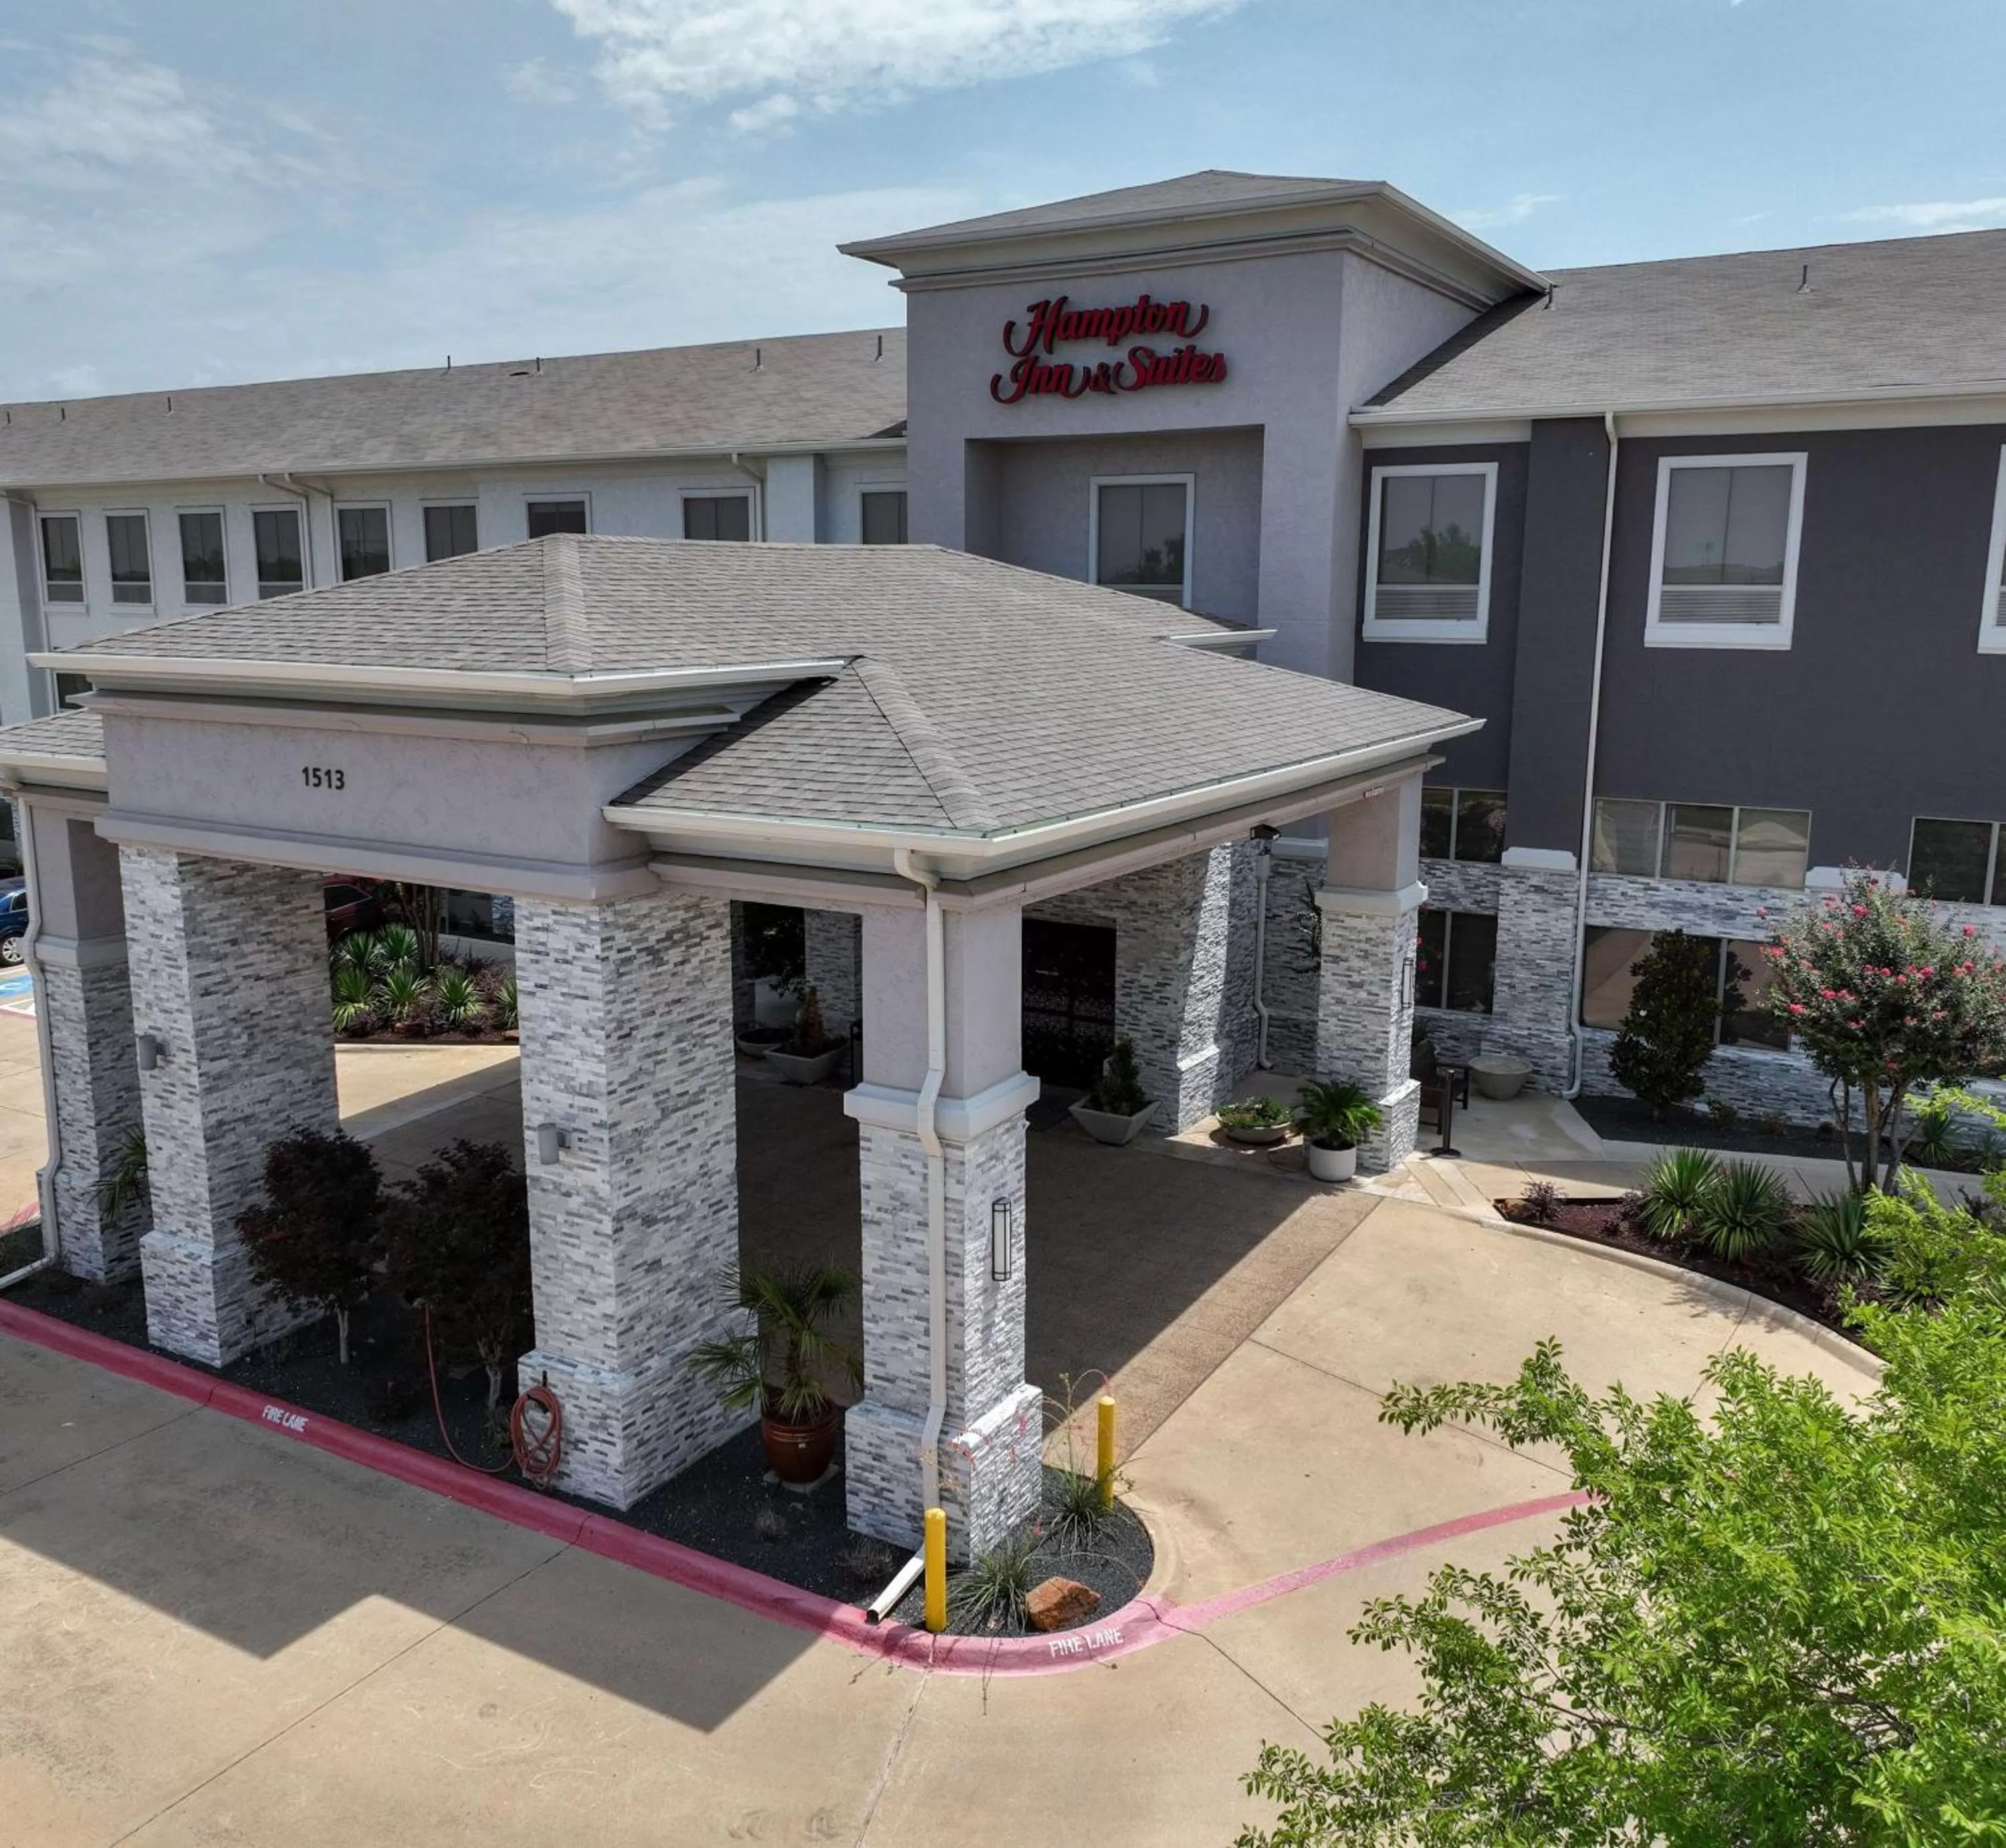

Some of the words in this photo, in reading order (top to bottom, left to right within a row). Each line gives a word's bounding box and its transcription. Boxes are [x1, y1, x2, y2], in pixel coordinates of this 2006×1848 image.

[1003, 294, 1210, 357] Hampton
[990, 355, 1091, 404] Inn
[1090, 362, 1117, 395] &
[1113, 344, 1226, 391] Suites
[302, 766, 345, 790] 1513
[262, 1405, 284, 1423] FIRE
[282, 1411, 309, 1433] LANE
[1048, 1637, 1084, 1658] FIRE
[1083, 1627, 1124, 1649] LANE
